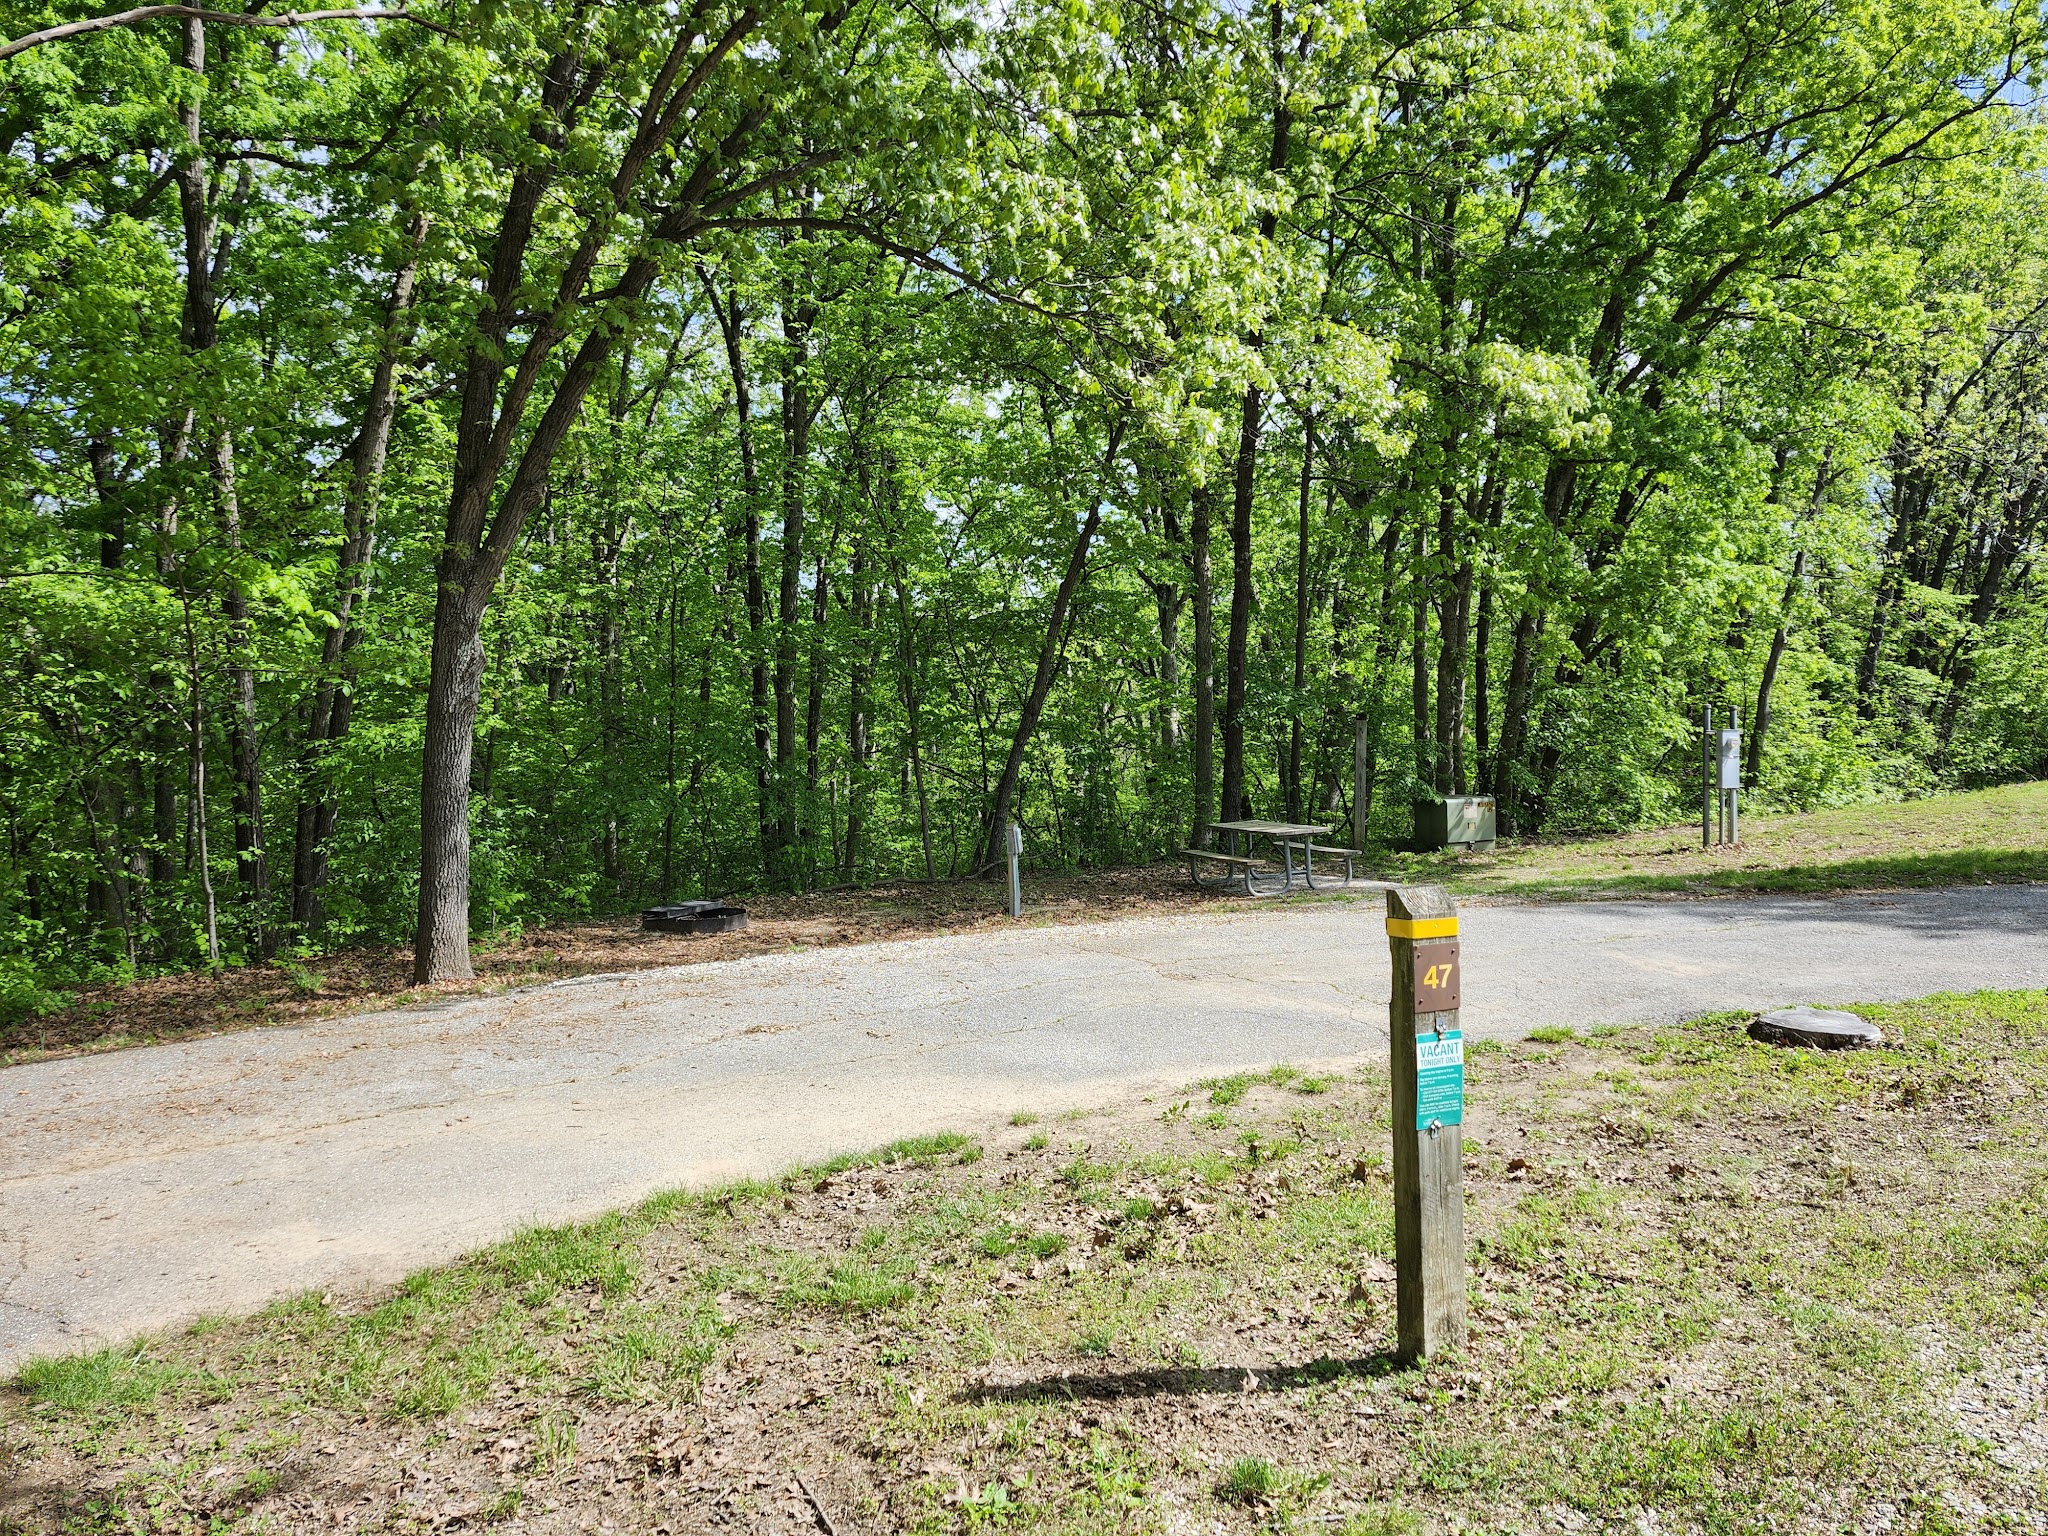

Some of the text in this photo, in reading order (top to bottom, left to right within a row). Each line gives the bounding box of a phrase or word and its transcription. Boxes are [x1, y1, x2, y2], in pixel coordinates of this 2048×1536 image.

[1423, 963, 1453, 989] 47
[1420, 1042, 1460, 1058] VACANT
[1420, 1055, 1461, 1068] TONIGHT ONLY
